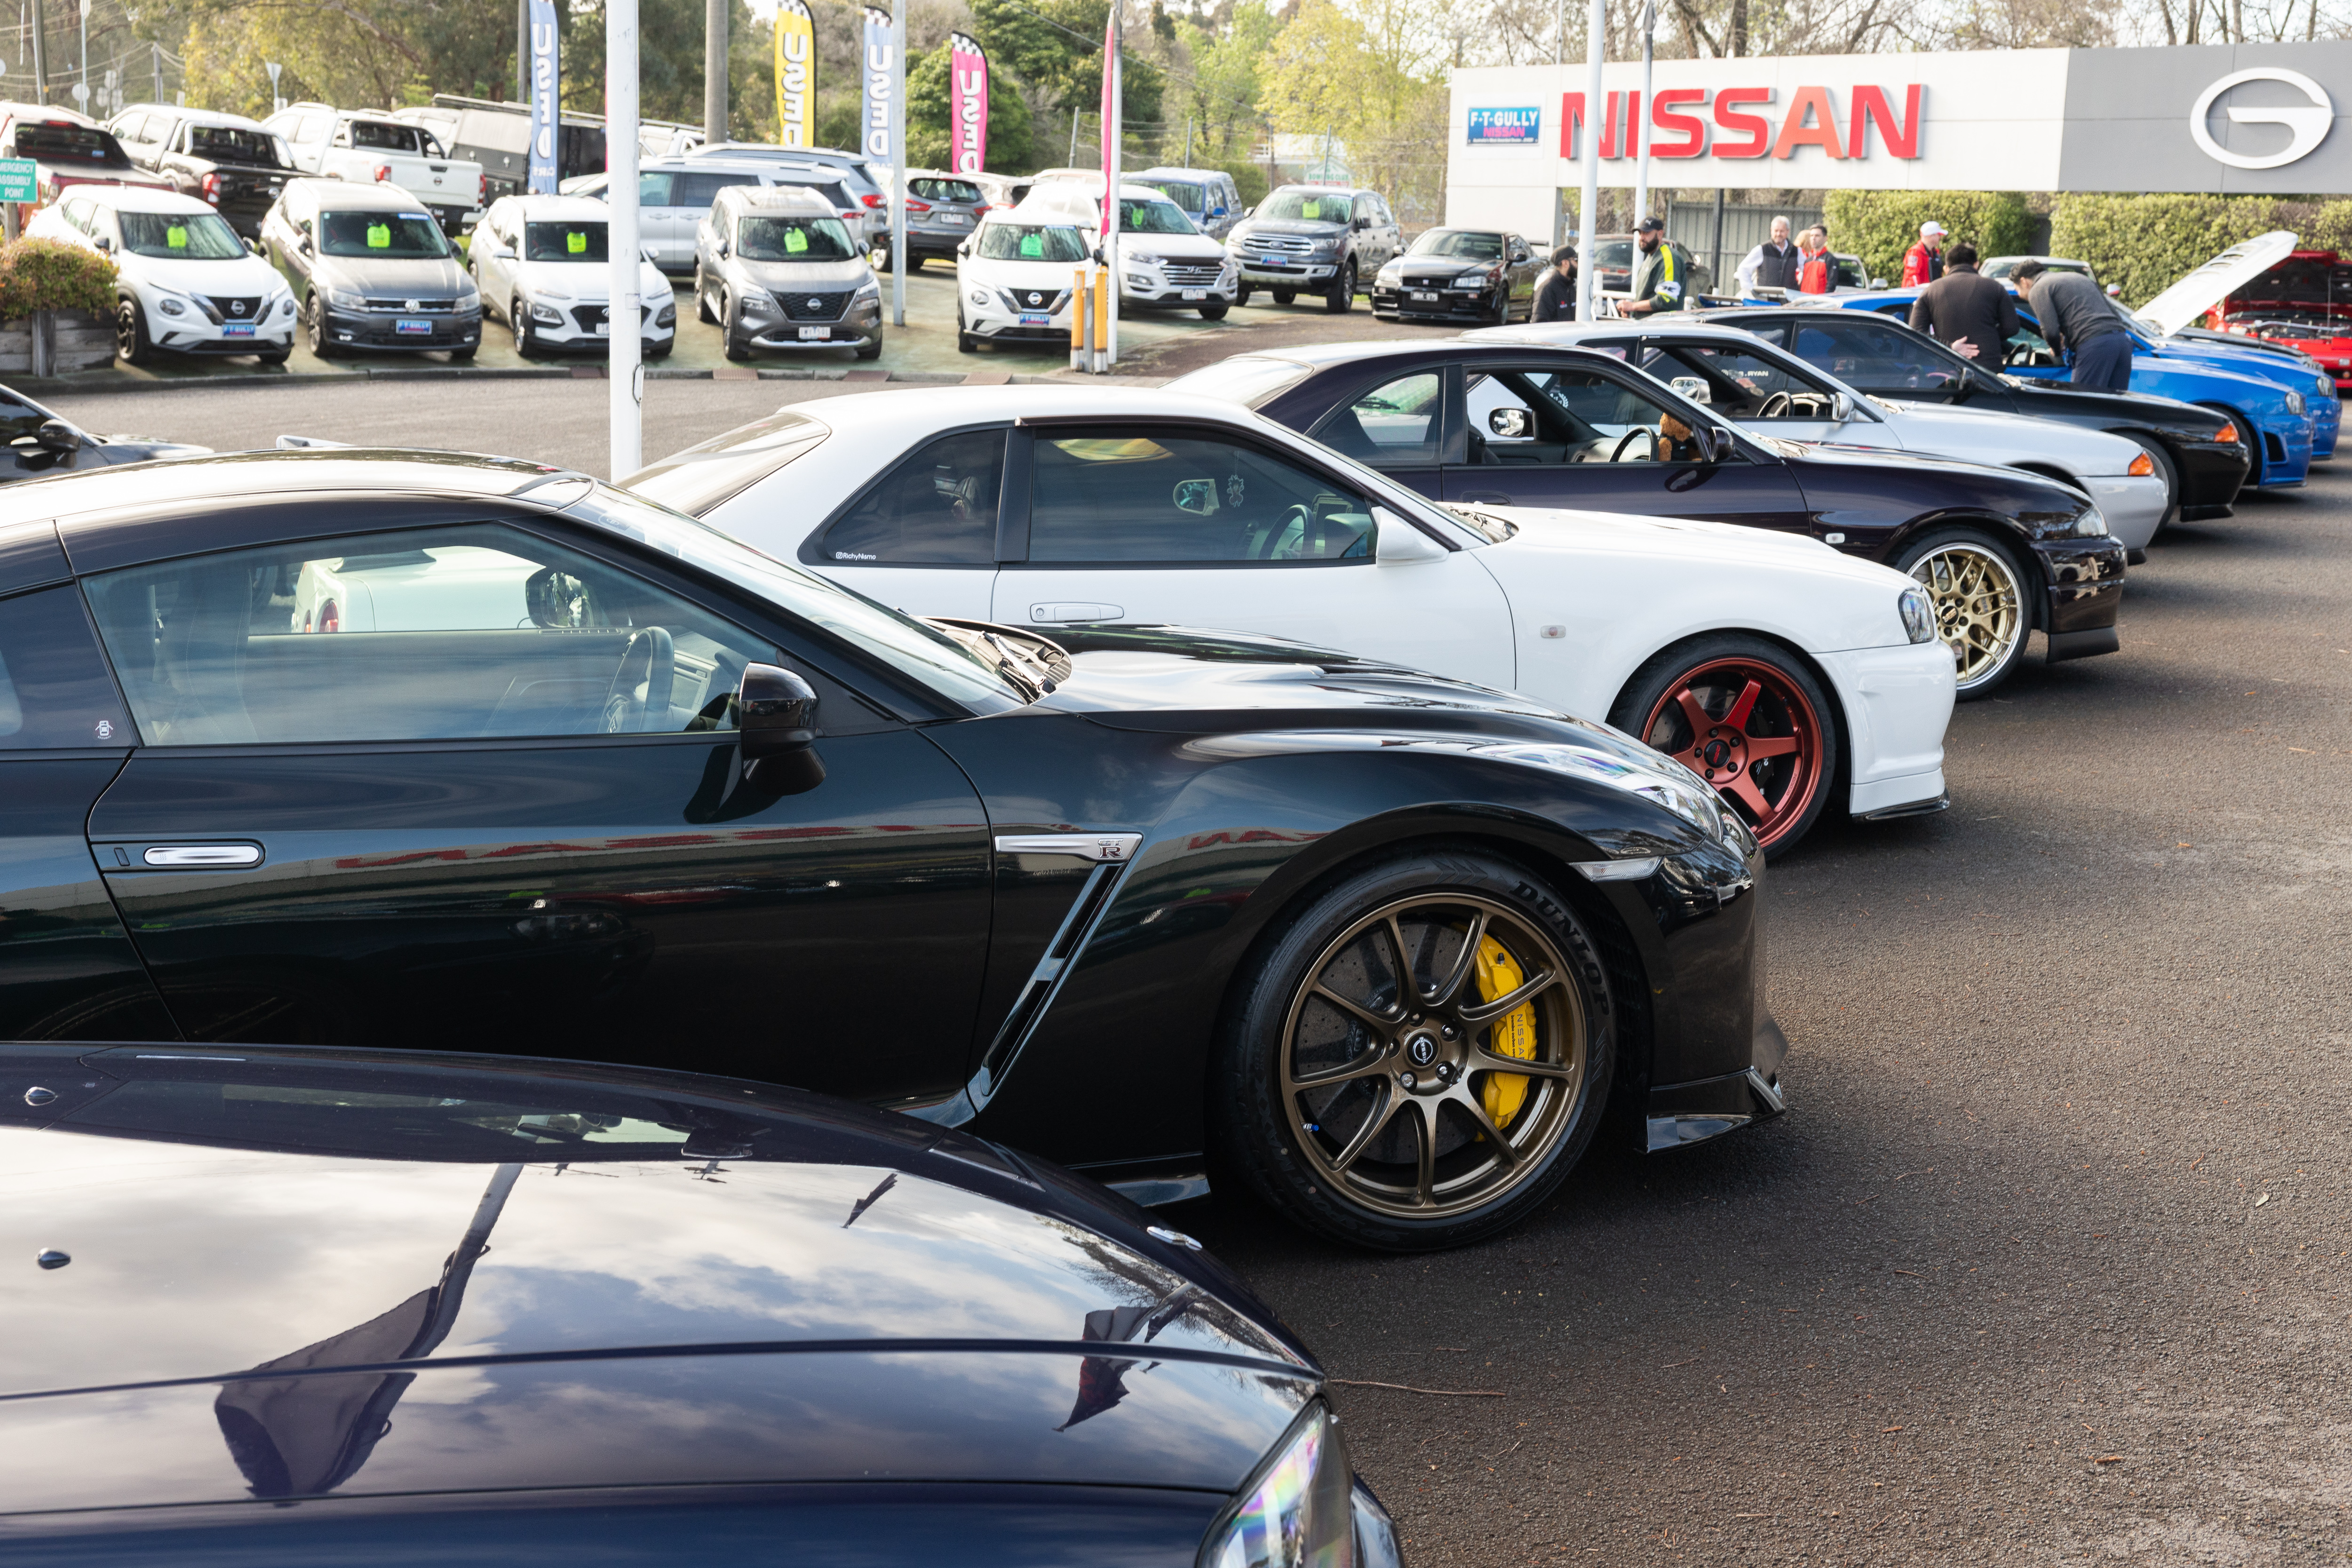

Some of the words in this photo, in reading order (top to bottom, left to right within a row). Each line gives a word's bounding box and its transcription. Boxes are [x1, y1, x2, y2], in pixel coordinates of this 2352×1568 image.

[1483, 126, 1526, 137] NISSAN
[1560, 84, 1928, 158] NISSAN
[0, 162, 34, 174] MERGENCY
[4, 187, 24, 198] POINT
[843, 552, 876, 561] RichyNismo
[1509, 881, 1610, 1016] DUNLOP
[1419, 1036, 1427, 1064] NISSAN
[1255, 1074, 1296, 1172] MAXX
[1287, 1173, 1366, 1230] SPORT
